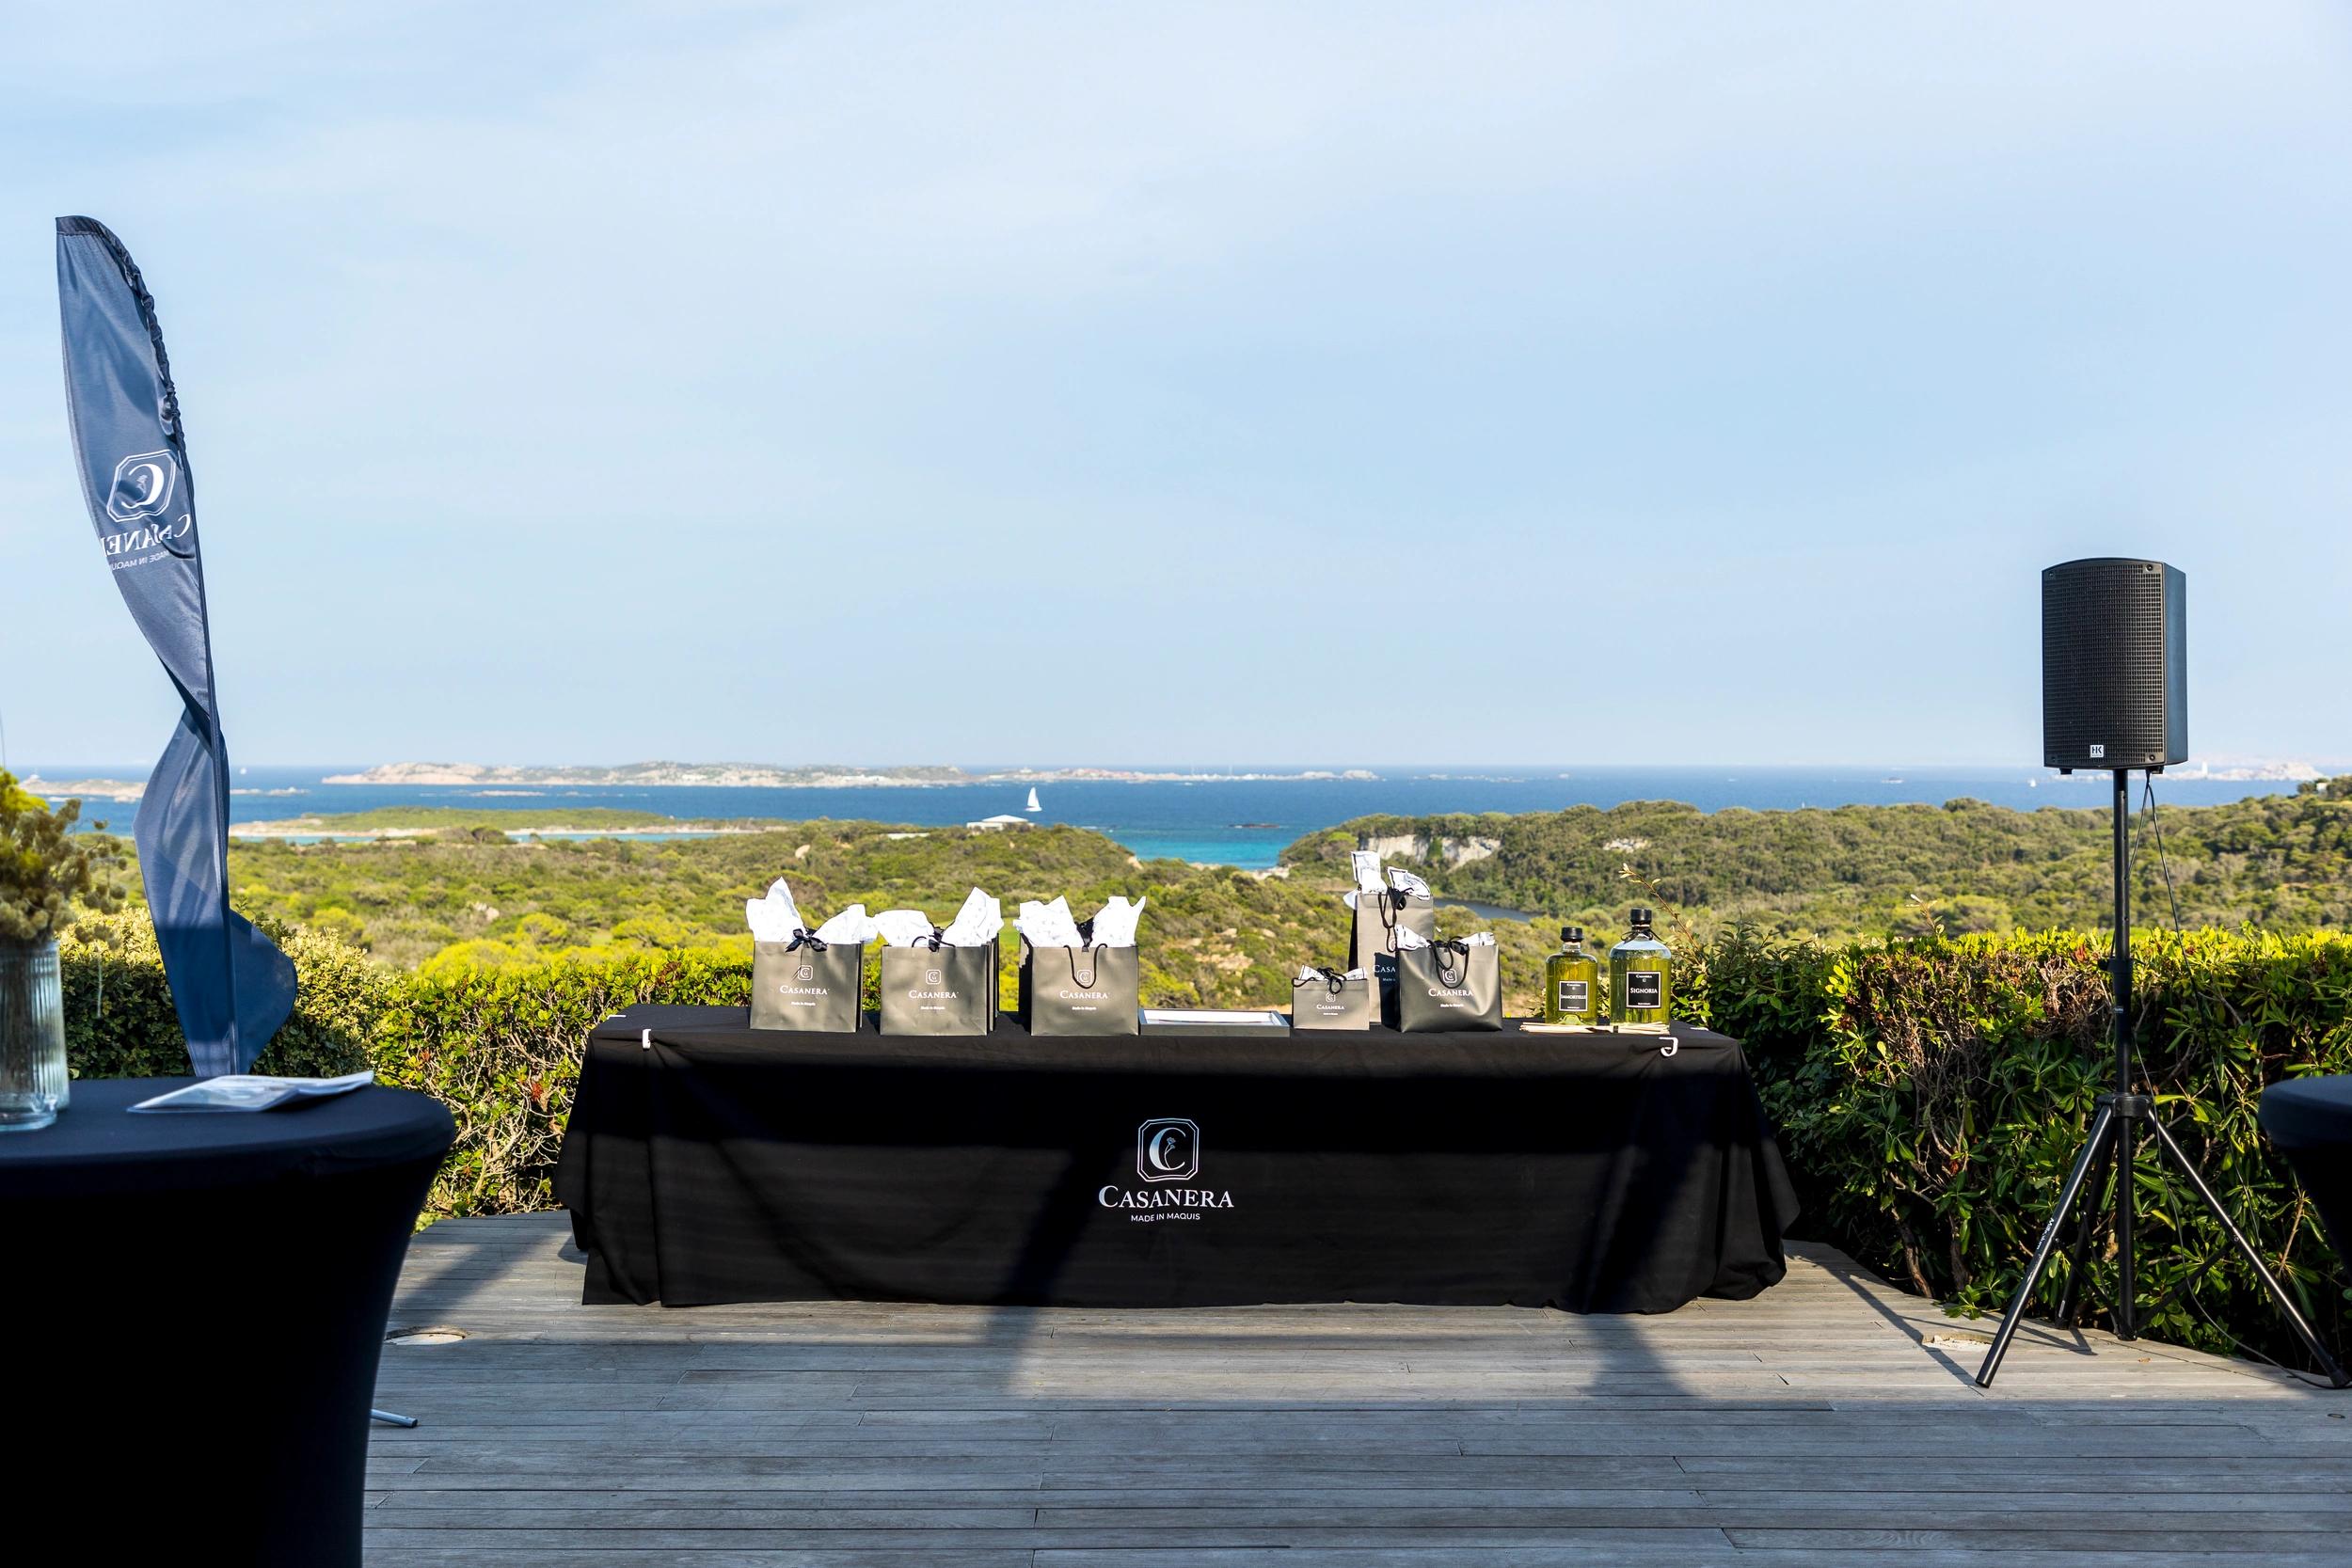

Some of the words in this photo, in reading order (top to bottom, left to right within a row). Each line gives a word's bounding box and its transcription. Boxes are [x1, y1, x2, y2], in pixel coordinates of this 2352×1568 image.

[1373, 964, 1396, 973] CASA
[779, 985, 828, 995] CASANERA
[908, 990, 957, 999] CASANERA
[1059, 990, 1108, 999] CASANERA
[1427, 988, 1473, 997] CASANERA
[1098, 1185, 1234, 1209] CASANERA
[1131, 1214, 1155, 1223] MADE
[1167, 1212, 1200, 1221] MAQUIS
